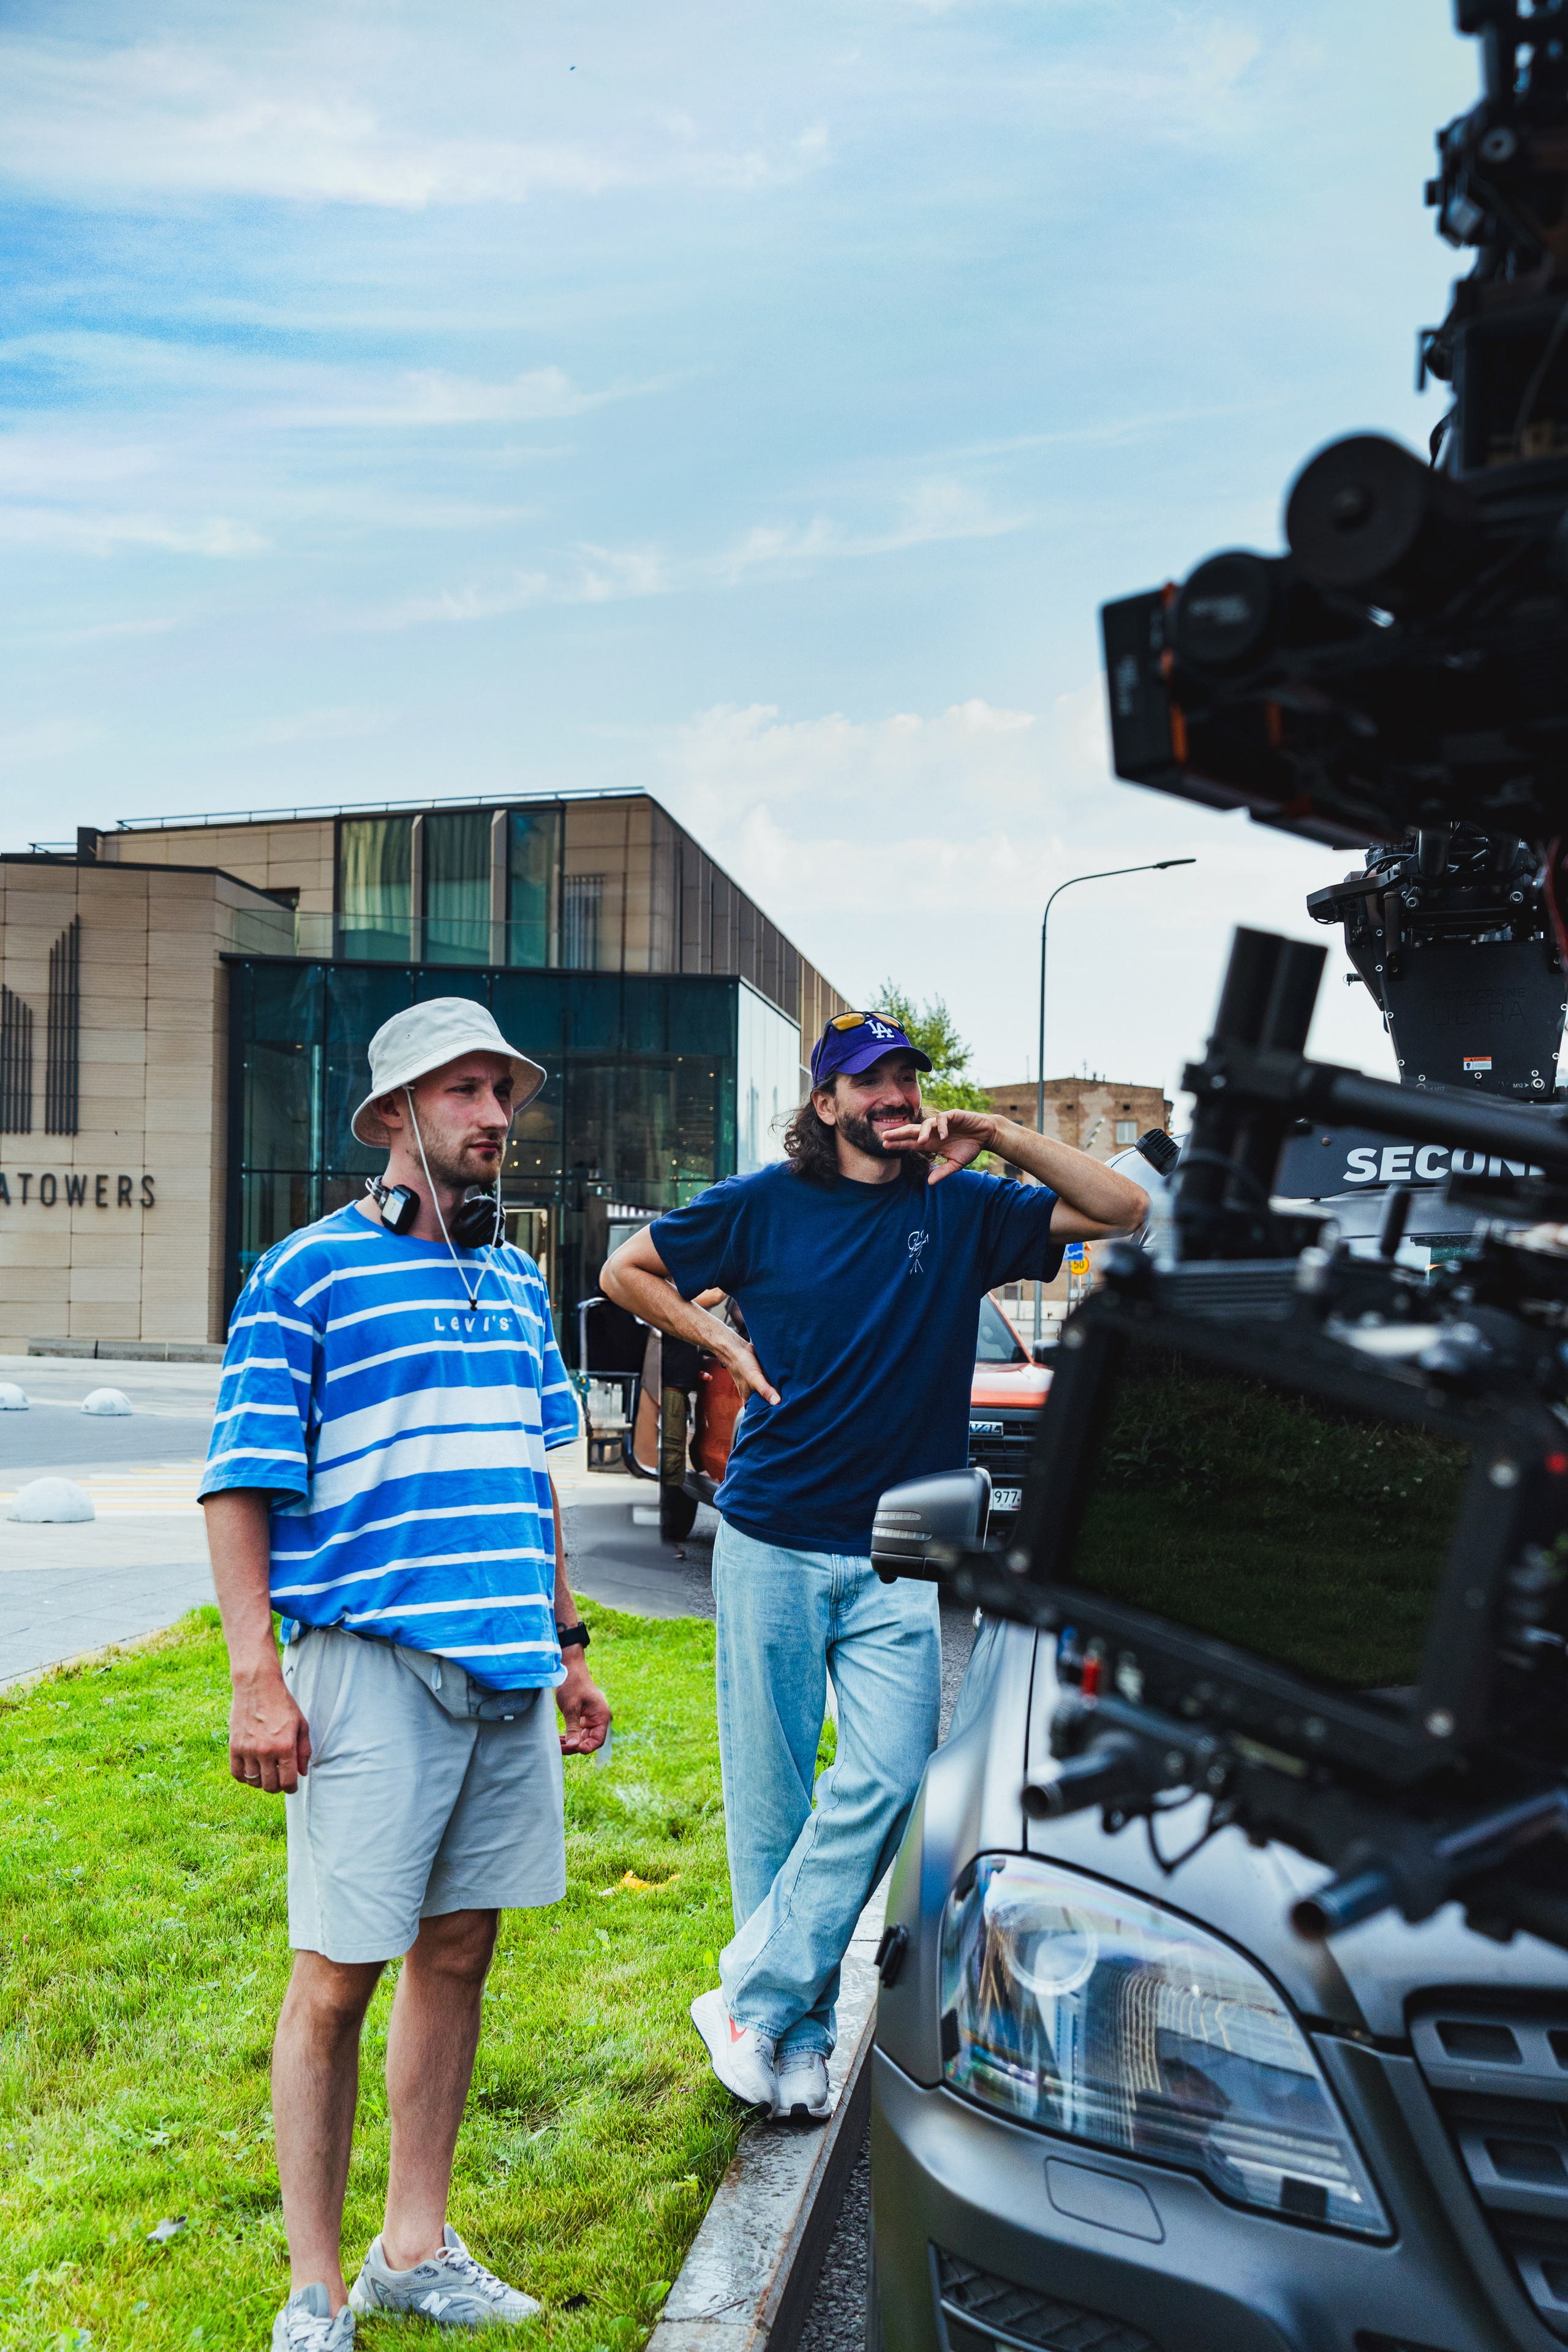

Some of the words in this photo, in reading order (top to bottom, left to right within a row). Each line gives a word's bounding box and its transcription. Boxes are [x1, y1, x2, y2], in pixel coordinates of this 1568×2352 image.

[1432, 987, 1526, 1001] MOTOCRANE
[1432, 1001, 1526, 1025] ULTRA
[865, 1019, 895, 1039] LA
[1342, 1144, 1547, 1182] SECON
[0, 1172, 155, 1208] ATOWERS
[1073, 1260, 1085, 1269] 50
[994, 1490, 1018, 1504] 977
